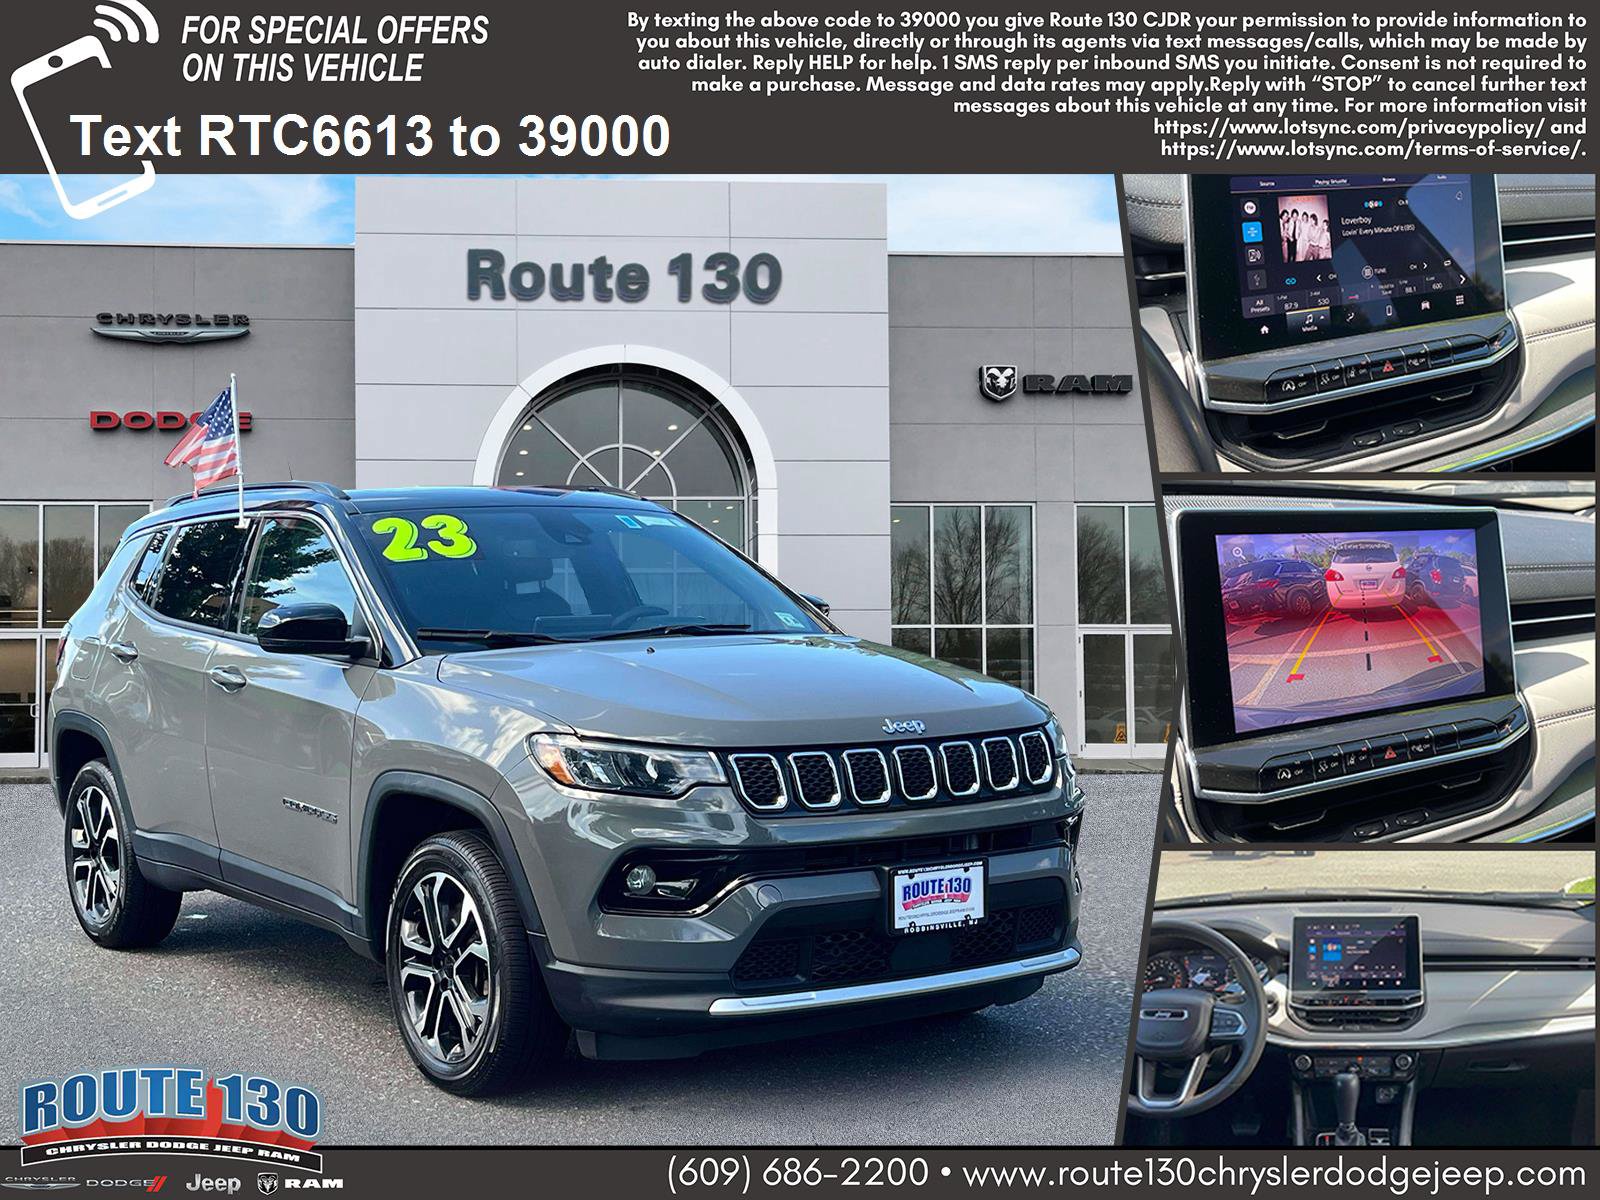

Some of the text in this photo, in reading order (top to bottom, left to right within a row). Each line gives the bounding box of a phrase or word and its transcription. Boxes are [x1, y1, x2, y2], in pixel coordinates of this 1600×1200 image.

[1341, 216, 1372, 226] Loverboy
[1359, 228, 1374, 237] Every
[1374, 227, 1392, 235] Minute
[466, 248, 783, 304] Route 130
[1284, 301, 1299, 310] 87.9
[1318, 297, 1330, 306] 530
[95, 312, 250, 326] CHRYSLER
[1022, 374, 1133, 394] RAM
[371, 513, 478, 563] 23
[882, 718, 926, 735] Jeep
[903, 877, 972, 902] ROUTE 130
